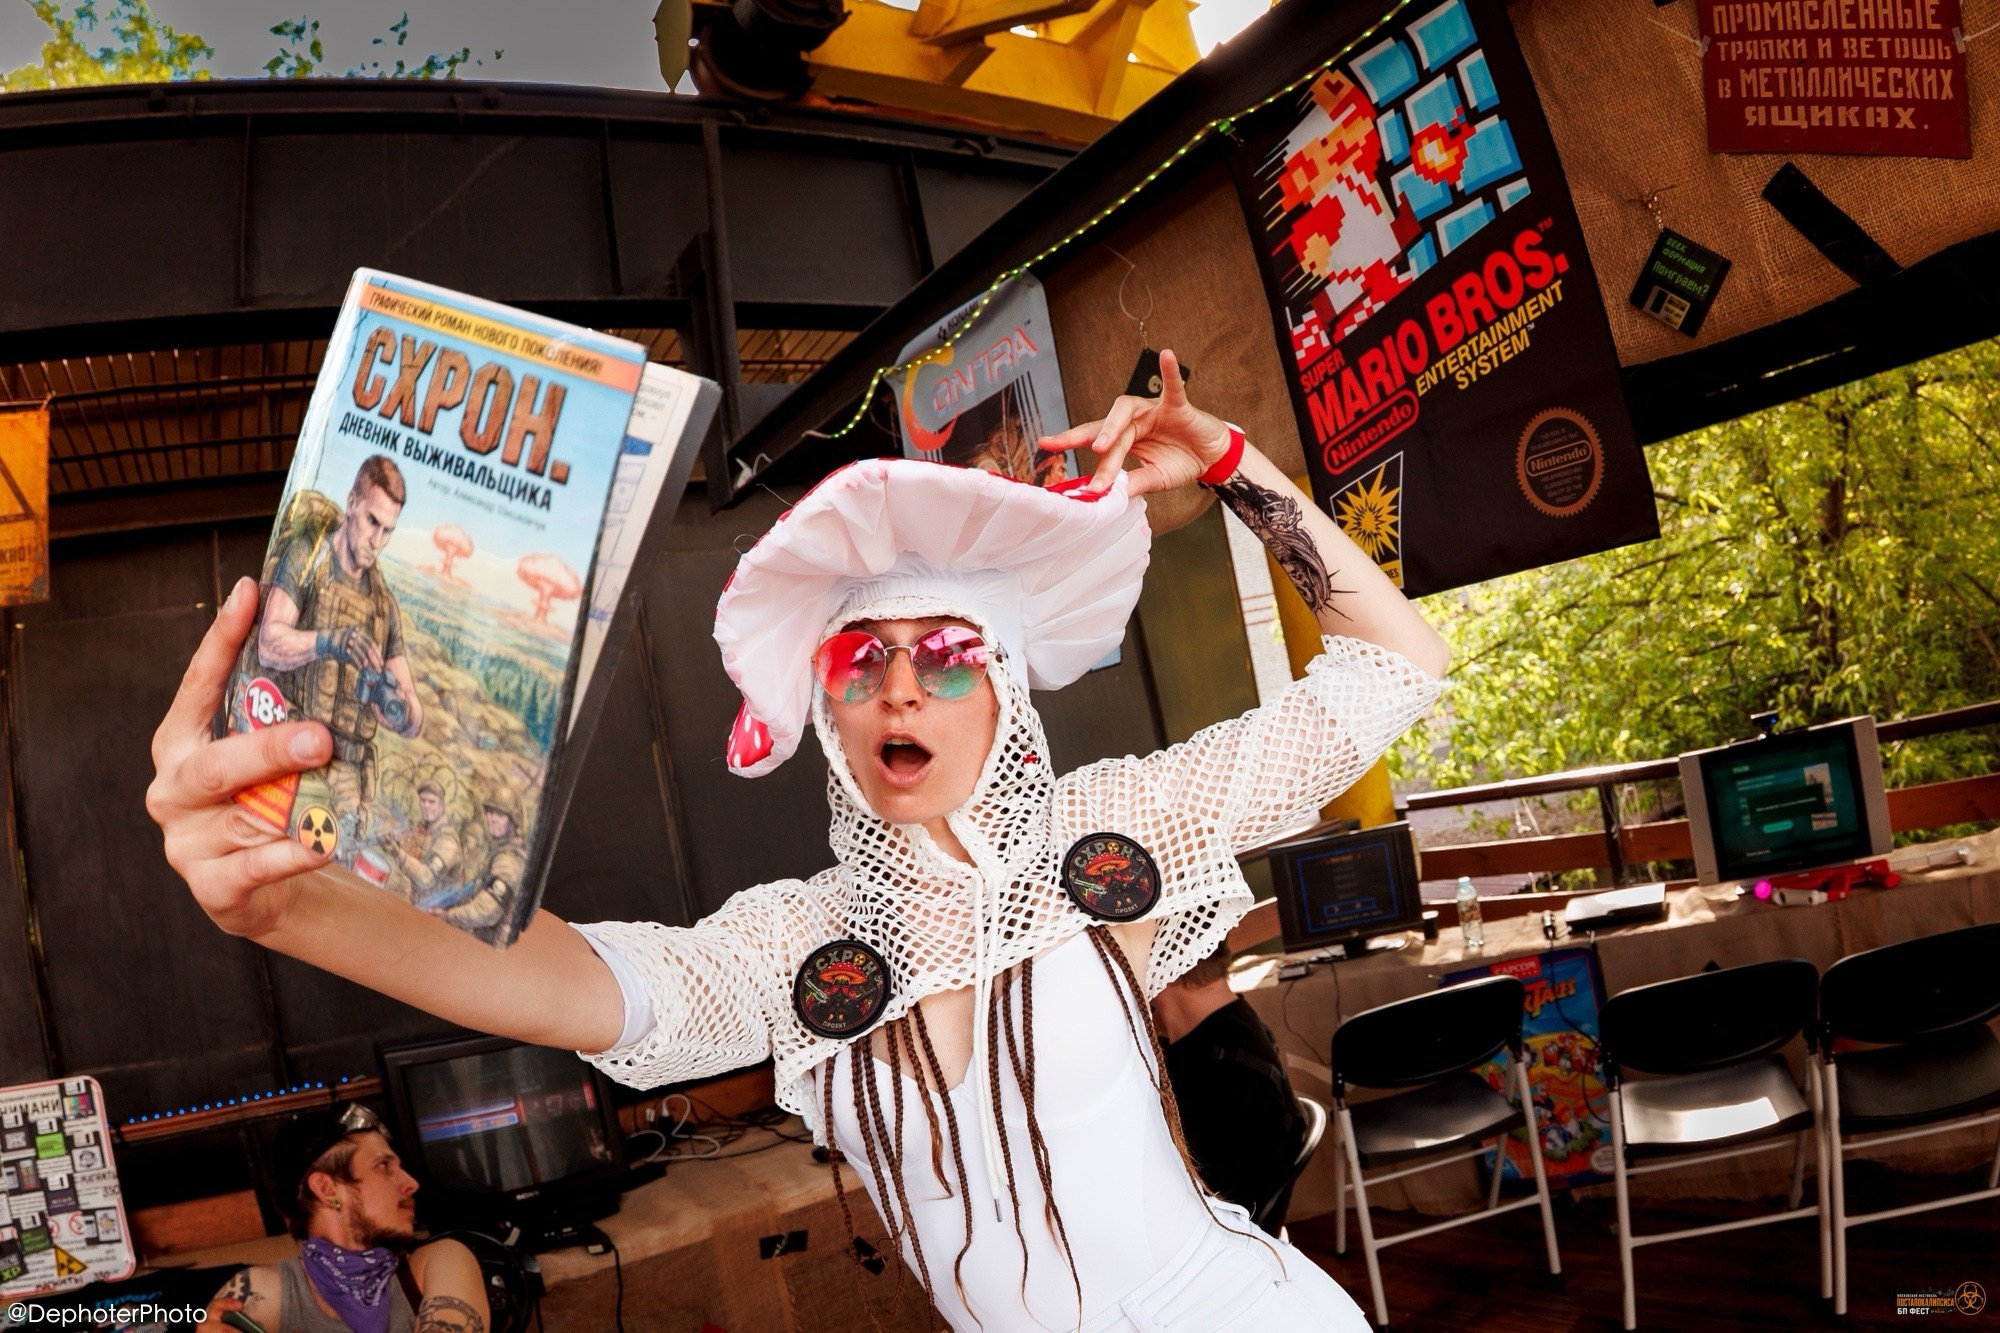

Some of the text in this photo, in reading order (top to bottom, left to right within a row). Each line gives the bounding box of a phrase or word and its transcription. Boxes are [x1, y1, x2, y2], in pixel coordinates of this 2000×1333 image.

[1712, 0, 1943, 34] ПРОМАСЛЕННЫЕ
[1717, 37, 1953, 61] ТРЯПКИ И ВЕТОШЬ
[1740, 66, 1954, 100] МЕТАЛЛИЧЕСКИХ
[1744, 105, 1929, 129] ЯЩИКАХ.
[369, 291, 604, 376] ГРАФИЧЕСКИЙ РОМАН НОВОГО ПОКОЛЕНИЯ!
[1306, 320, 1429, 446] MARIO
[1426, 229, 1570, 355] BROS.
[1415, 280, 1565, 397] ENTERTAINMENT
[1455, 328, 1532, 391] SYSTEM
[1300, 349, 1346, 393] SUPER
[352, 325, 572, 486] СХРОН.
[1328, 400, 1413, 467] Nintendo
[1530, 446, 1588, 472] Nintendo
[338, 412, 553, 513] ДНЕВНИК ВЫЖИВАЛЬЩИКА
[249, 686, 286, 725] 18+
